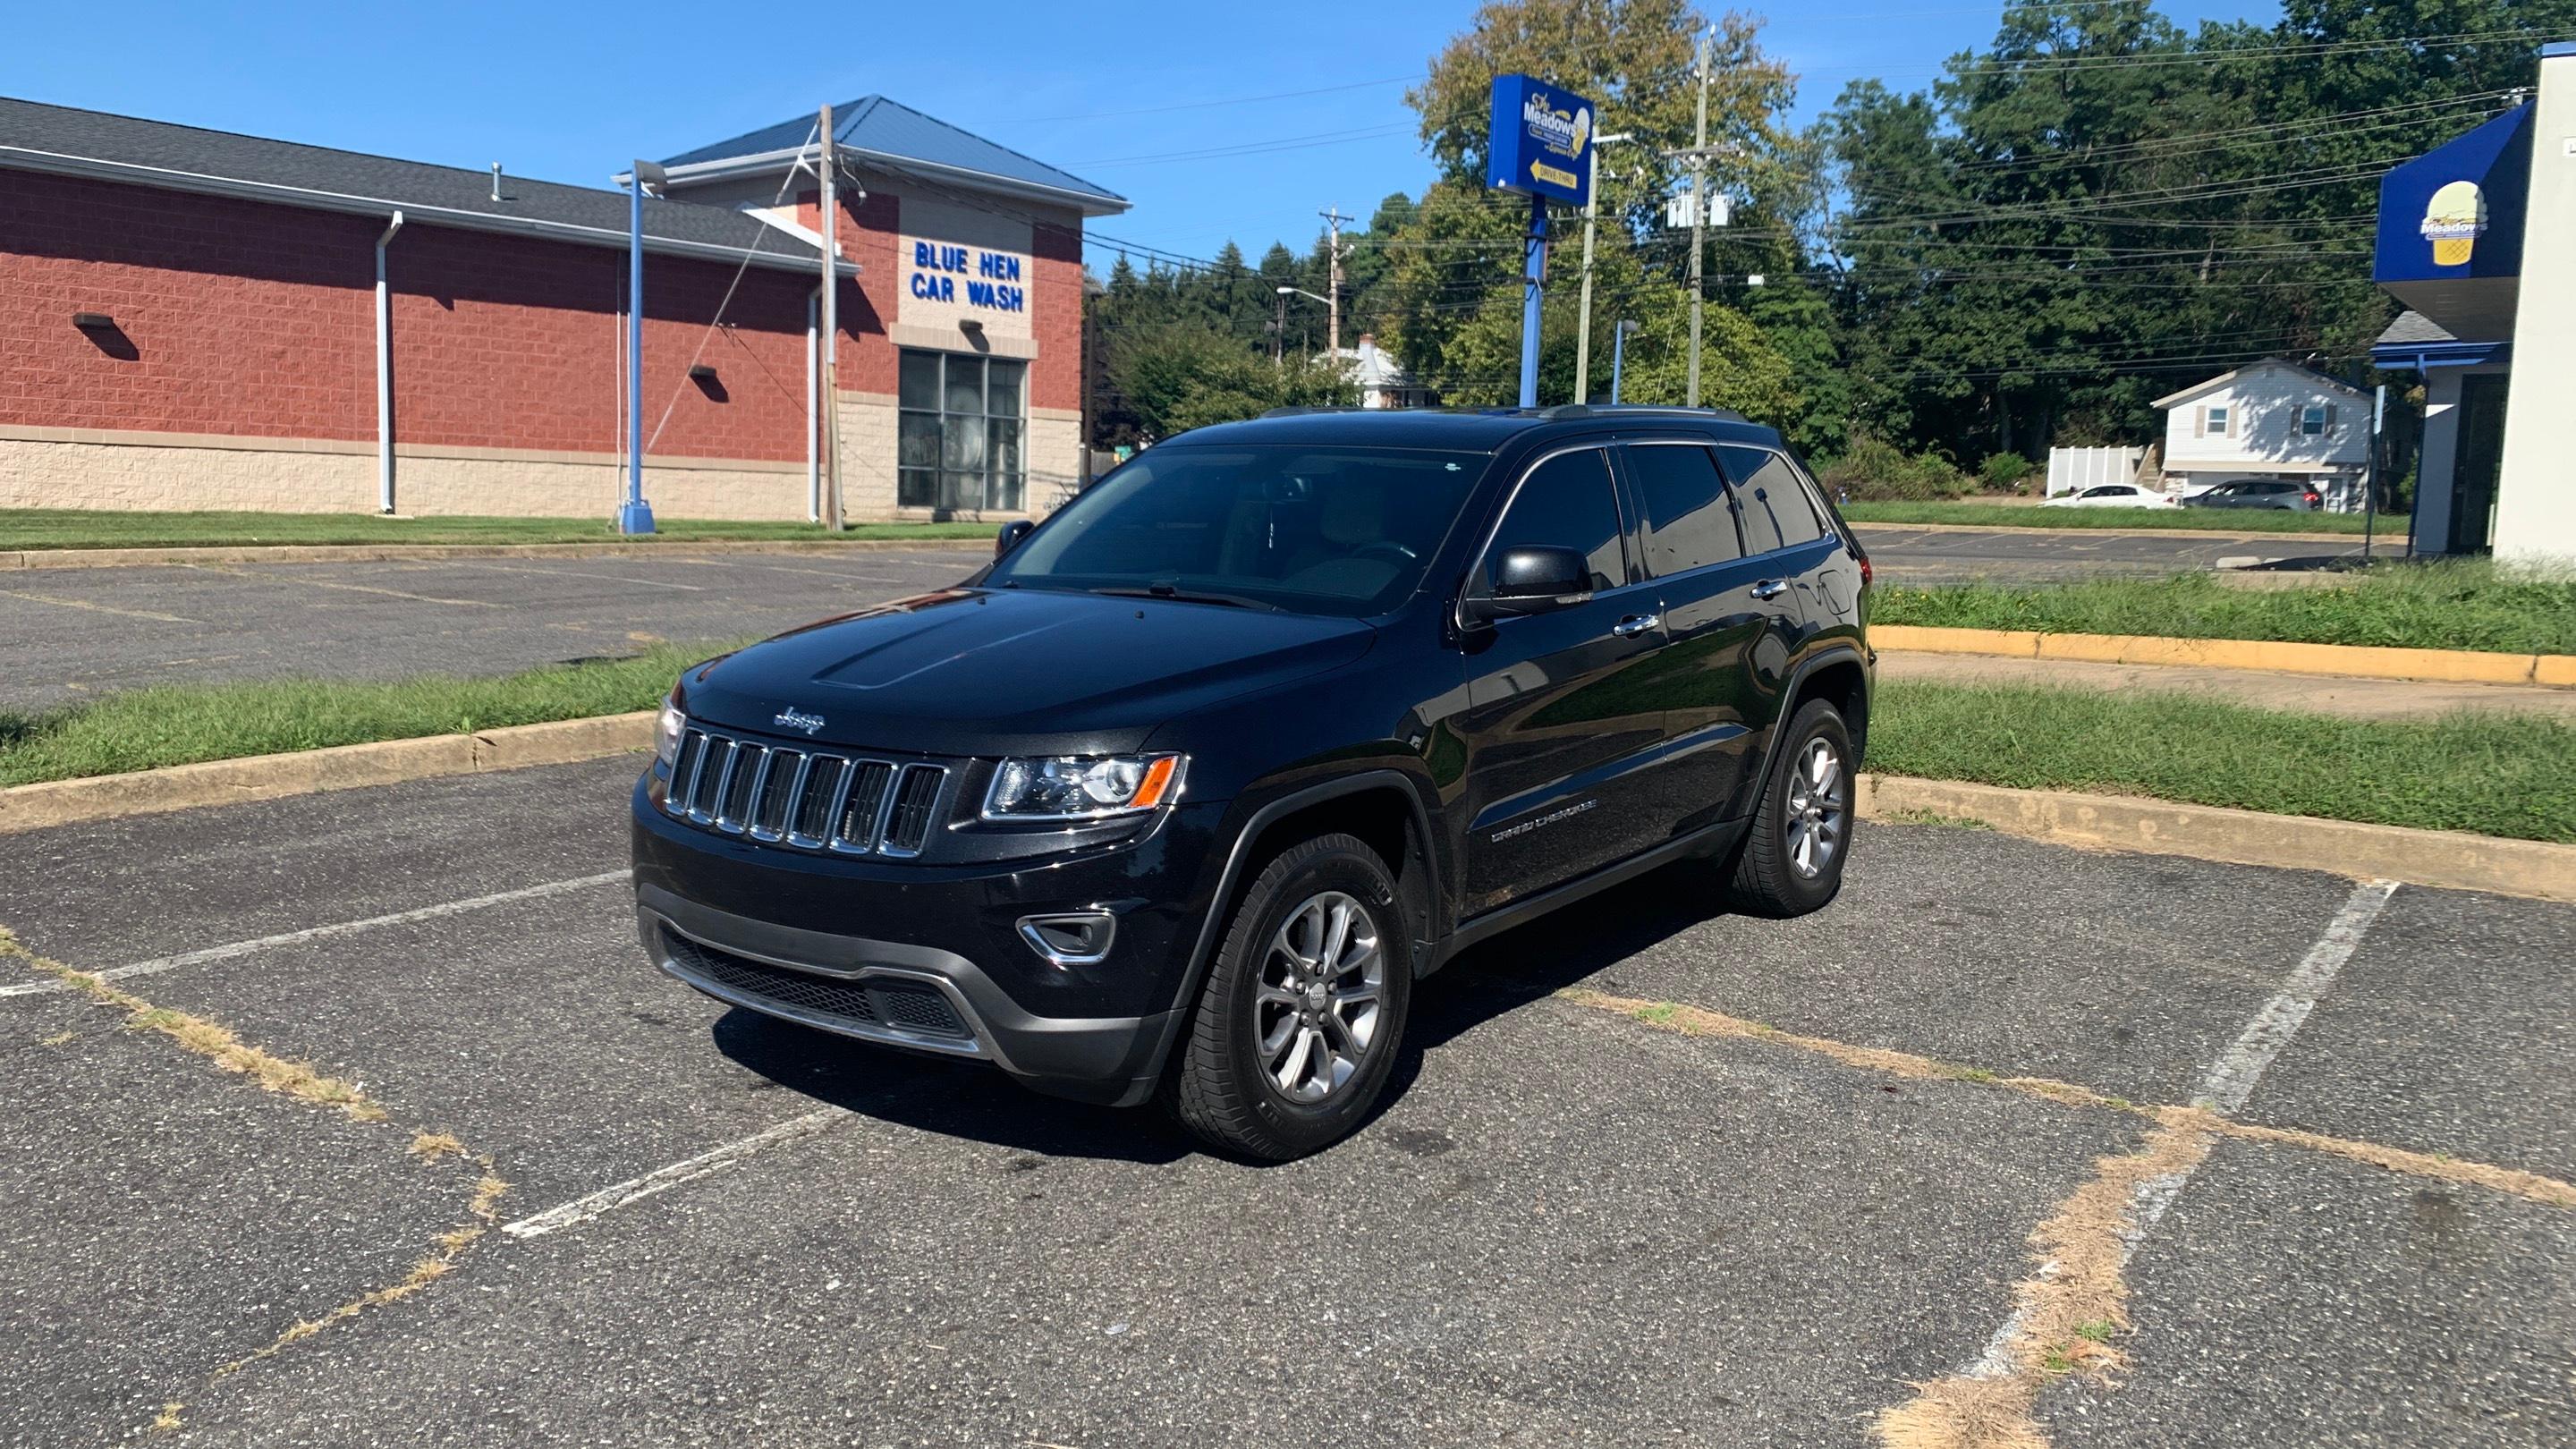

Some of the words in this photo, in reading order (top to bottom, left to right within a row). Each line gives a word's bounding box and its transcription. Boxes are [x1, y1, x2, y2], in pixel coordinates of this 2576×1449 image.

[1524, 101, 1577, 137] Meadows
[2420, 222, 2488, 234] Meadows
[915, 241, 969, 275] BLUE
[979, 251, 1021, 283] HEN
[911, 272, 955, 304] CAR
[966, 280, 1024, 313] WASH
[774, 706, 825, 735] Jeep
